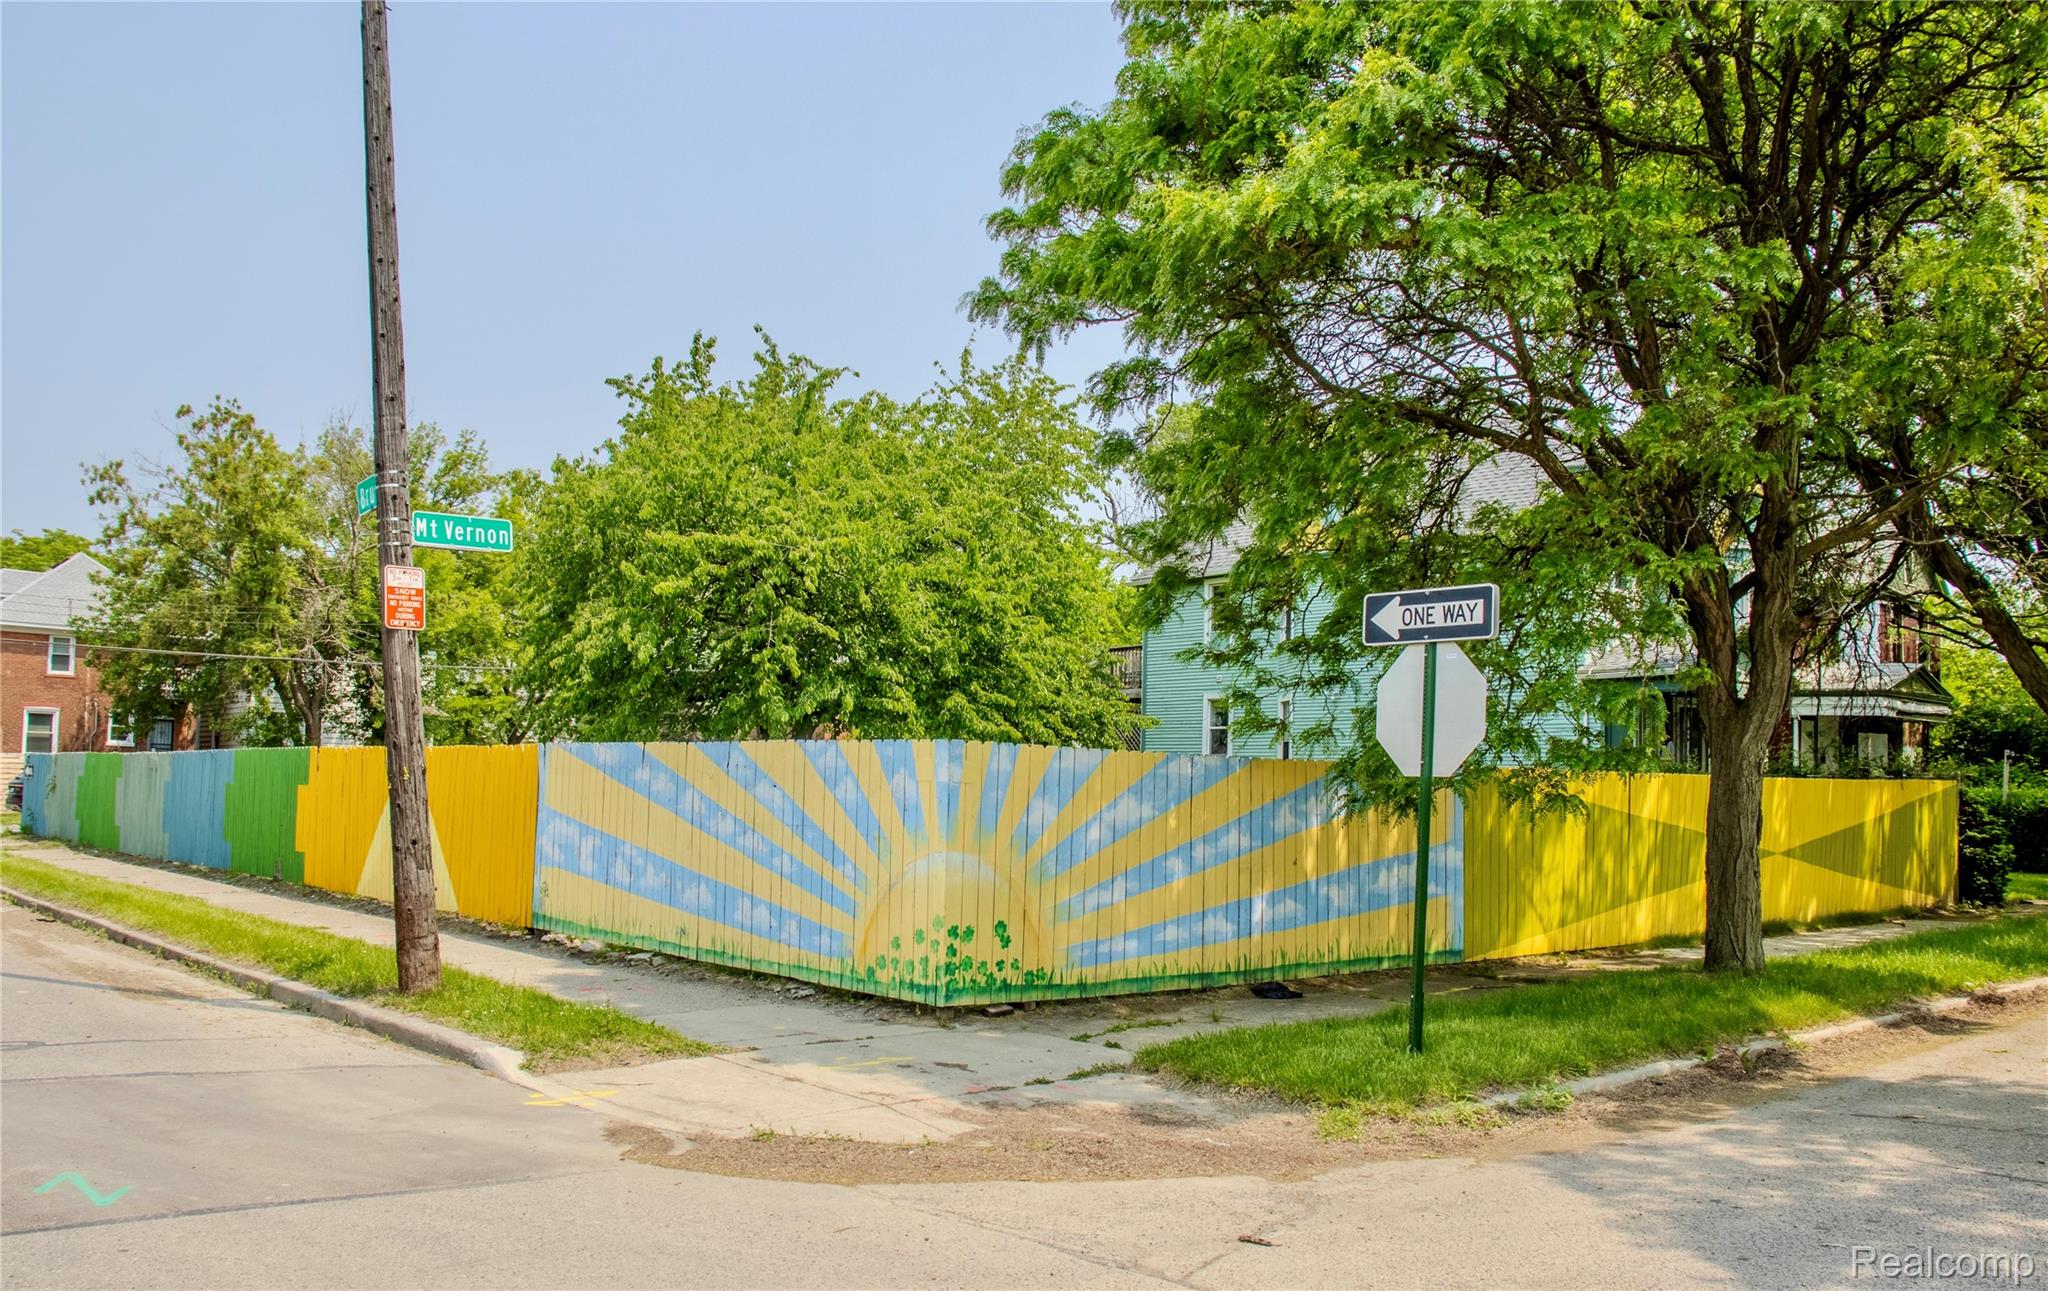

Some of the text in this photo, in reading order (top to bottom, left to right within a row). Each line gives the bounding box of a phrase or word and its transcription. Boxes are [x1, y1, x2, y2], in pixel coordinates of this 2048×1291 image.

[416, 518, 509, 545] Mt Vernon
[398, 600, 421, 608] PARKING
[395, 612, 416, 620] DURING
[1402, 602, 1478, 626] ONE WAY
